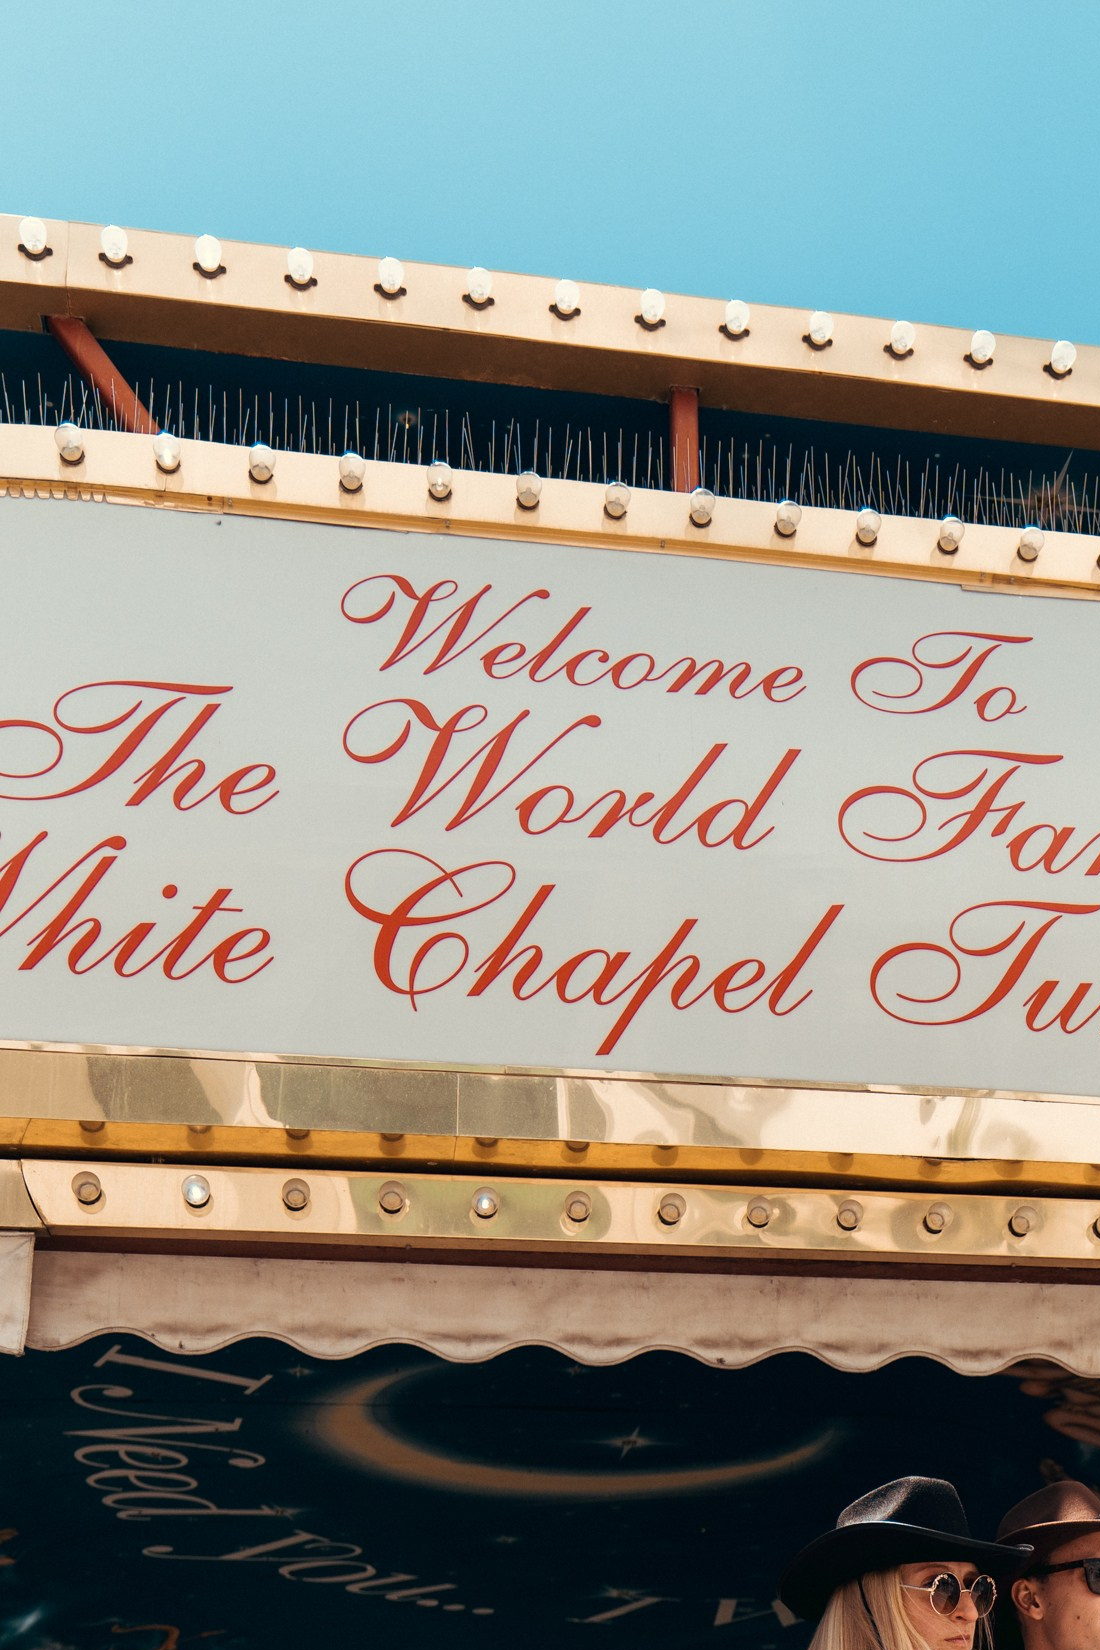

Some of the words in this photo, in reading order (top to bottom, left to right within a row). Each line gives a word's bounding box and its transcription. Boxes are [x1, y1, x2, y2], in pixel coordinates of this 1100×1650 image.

[340, 574, 806, 703] Welcome
[850, 631, 1033, 722] To
[0, 680, 279, 816] The
[342, 698, 802, 850] World
[344, 848, 844, 1056] Chapel
[94, 1343, 273, 1396] I
[64, 1384, 290, 1521] Need
